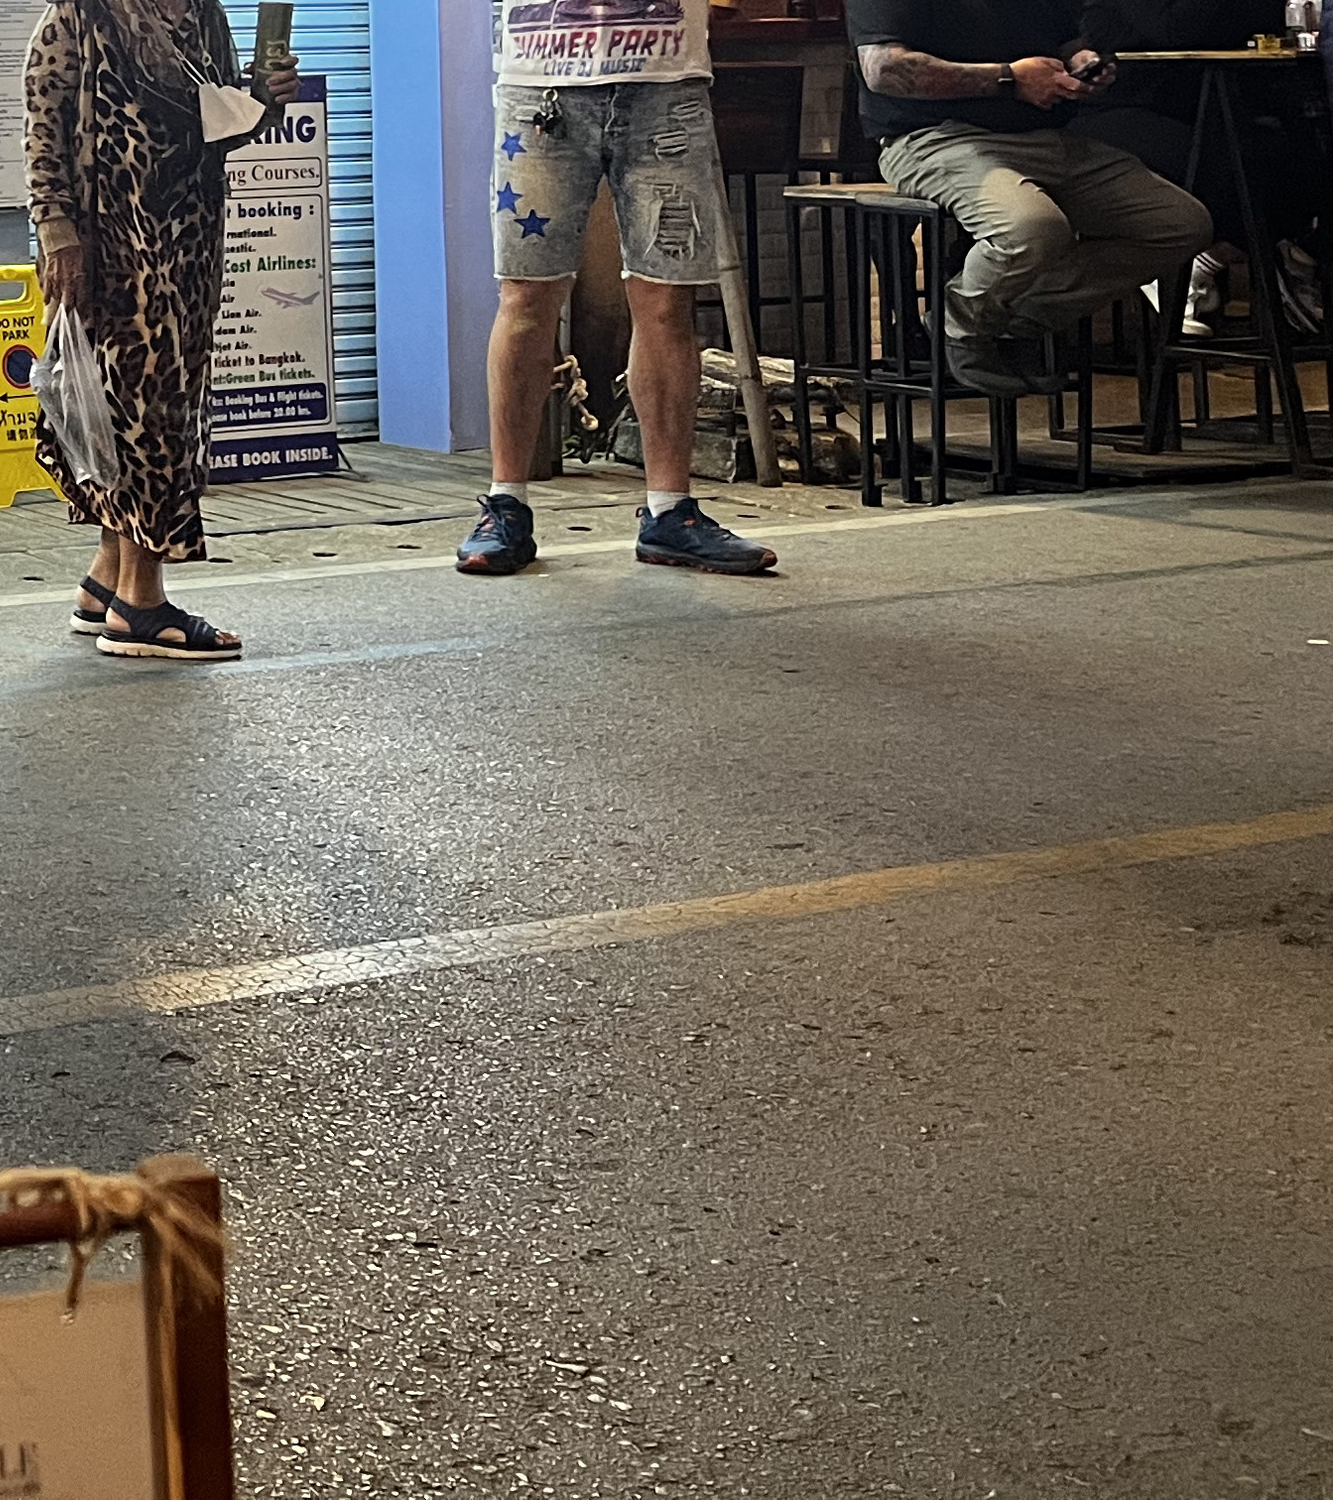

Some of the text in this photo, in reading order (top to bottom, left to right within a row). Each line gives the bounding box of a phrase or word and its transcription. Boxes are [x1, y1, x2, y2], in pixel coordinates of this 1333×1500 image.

[607, 29, 685, 57] PARTY
[544, 58, 647, 77] LIVE DJ MUSIC
[226, 164, 320, 186] ng Courses.
[238, 201, 302, 220] booking
[227, 227, 277, 239] rnational.
[257, 255, 316, 271] Airlines:
[13, 316, 35, 328] NOT
[2, 329, 30, 341] PARK
[245, 356, 255, 366] to
[259, 351, 305, 367] Bangkok.
[229, 410, 247, 420] book
[249, 408, 271, 419] before
[209, 447, 333, 469] EASE BOOK INSIDE.
